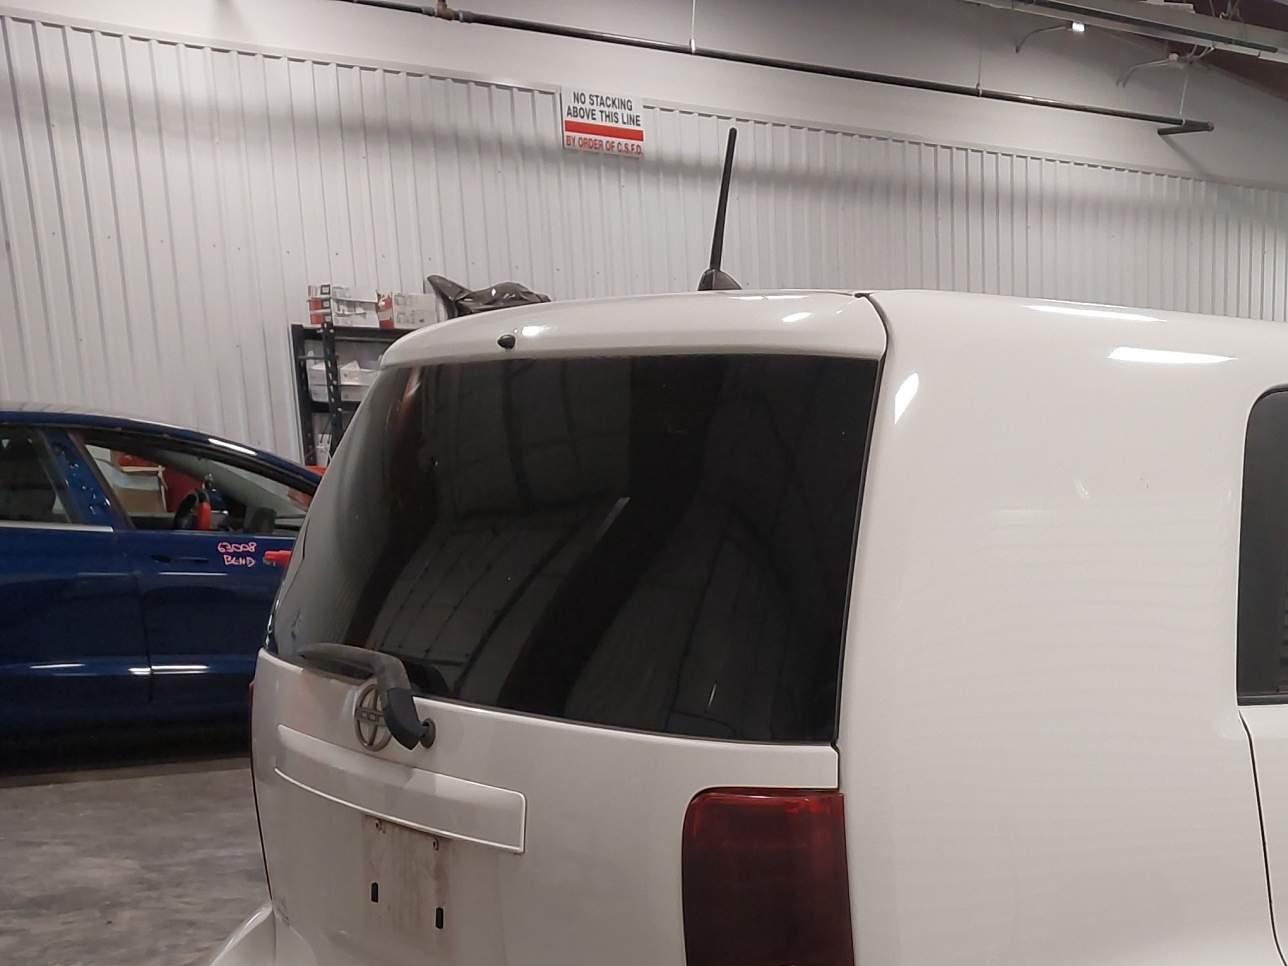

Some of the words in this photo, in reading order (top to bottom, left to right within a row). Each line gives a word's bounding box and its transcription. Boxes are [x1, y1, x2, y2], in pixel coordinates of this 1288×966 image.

[573, 91, 586, 105] NO
[589, 94, 633, 111] STACKING
[566, 105, 597, 120] ABOVE
[599, 109, 619, 123] THIS
[621, 112, 641, 127] LINE
[566, 135, 576, 147] BY
[578, 137, 604, 150] ORDER
[605, 140, 616, 152] OF
